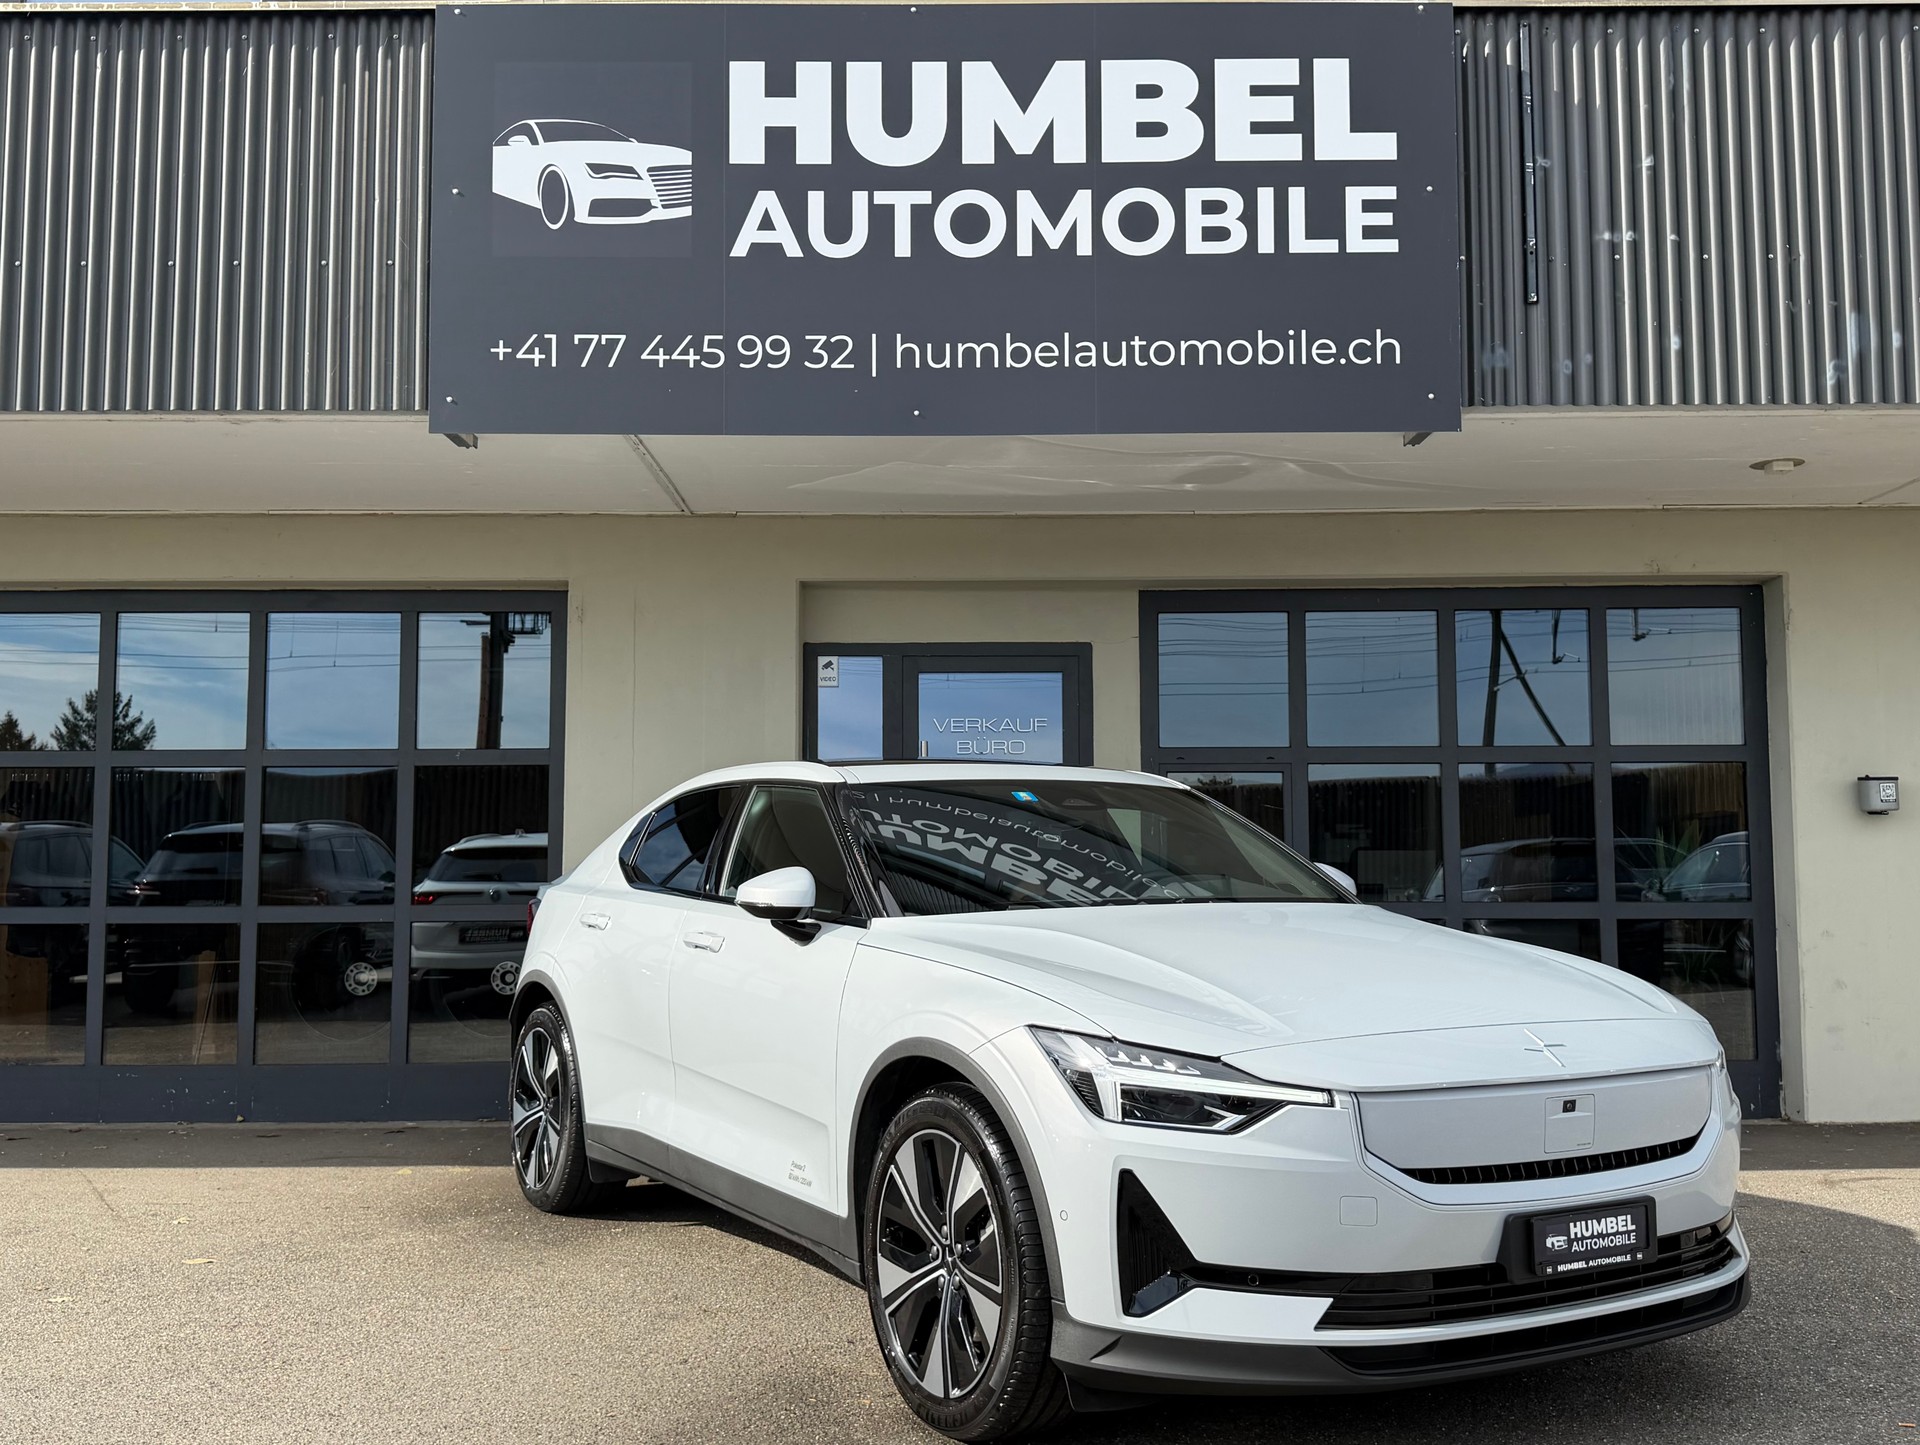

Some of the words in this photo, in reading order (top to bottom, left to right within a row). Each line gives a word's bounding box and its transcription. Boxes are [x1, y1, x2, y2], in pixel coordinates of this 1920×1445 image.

[728, 57, 1398, 167] HUMBEL
[729, 185, 1400, 259] AUTOMOBILE
[490, 333, 557, 368] +41
[573, 333, 627, 368] 77
[640, 334, 726, 369] 445
[736, 334, 791, 369] 99
[803, 334, 855, 369] 32
[896, 328, 1401, 369] humbelautomobile.ch
[933, 718, 1048, 733] VERKAUF
[956, 737, 1026, 755] BÜRO
[1569, 1214, 1636, 1239] HUMBEL
[1571, 1232, 1637, 1253] AUTOMOBILE
[1557, 1260, 1588, 1272] HUMBEL
[1588, 1254, 1632, 1267] AUTOMOBILE
